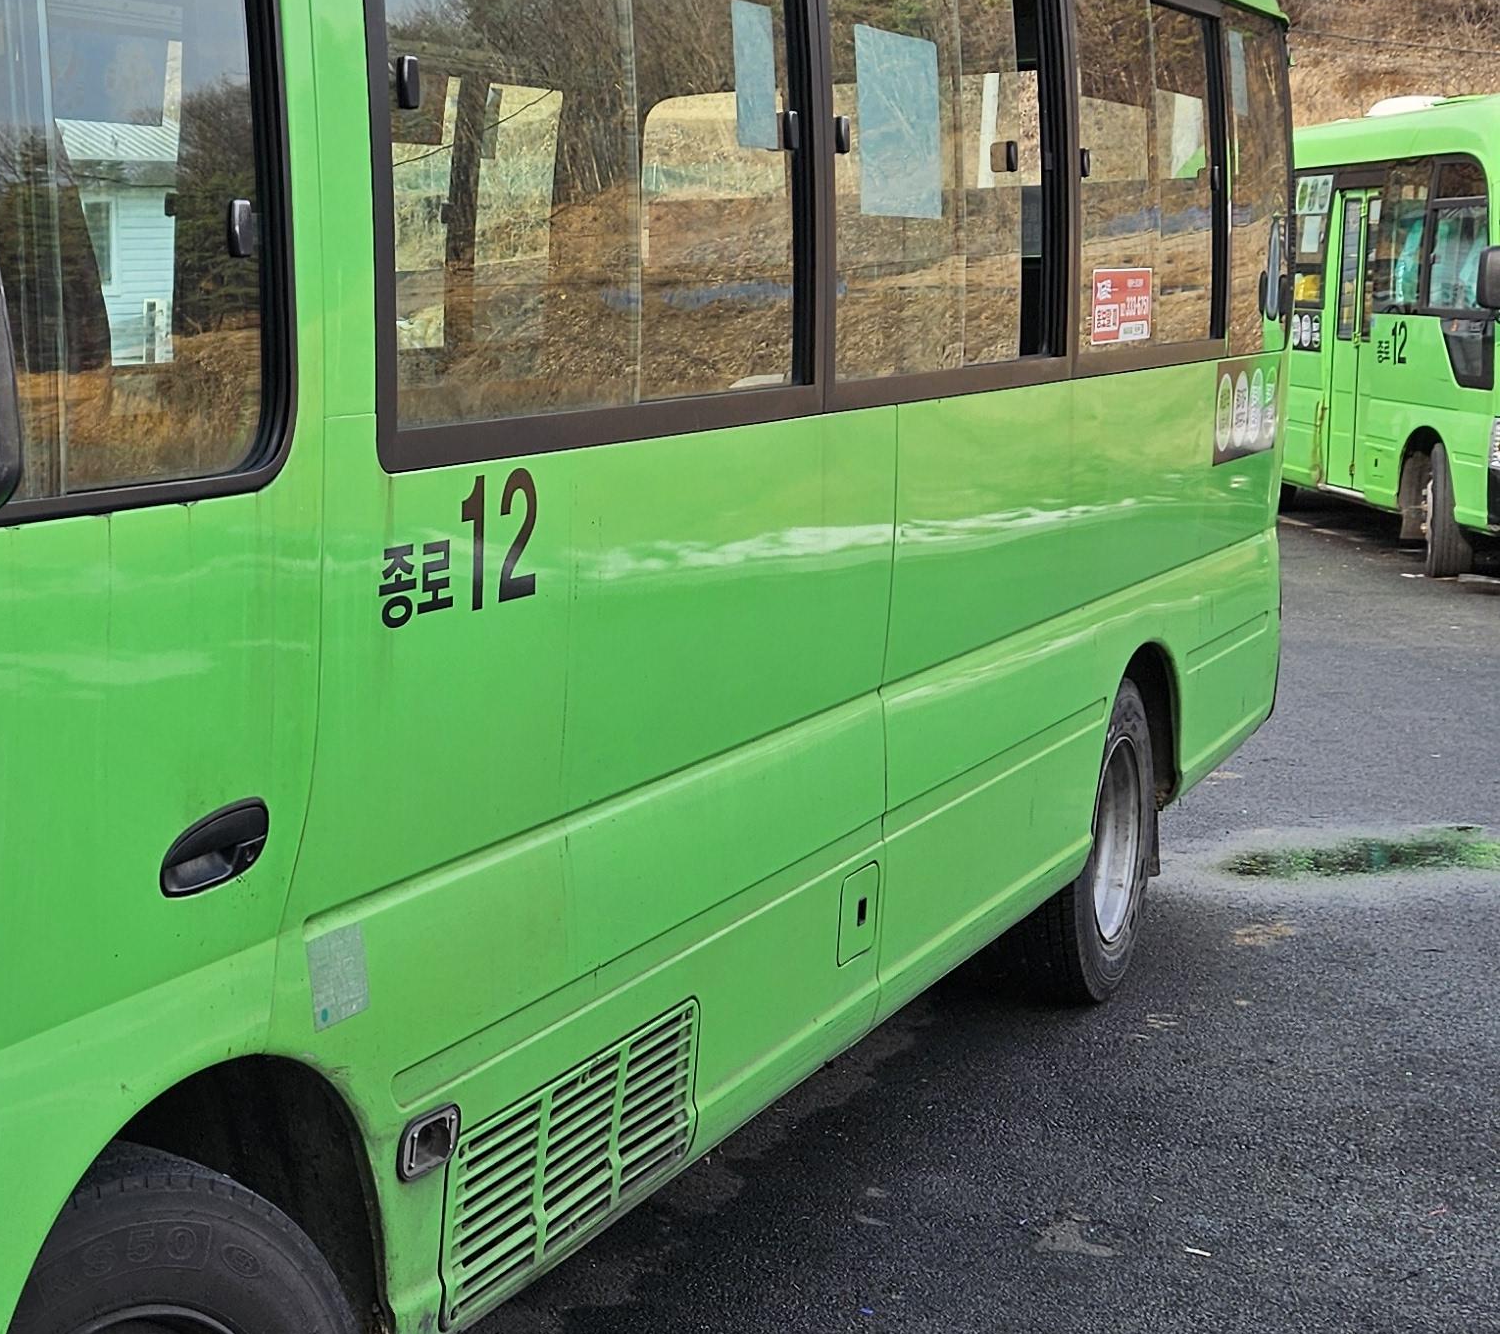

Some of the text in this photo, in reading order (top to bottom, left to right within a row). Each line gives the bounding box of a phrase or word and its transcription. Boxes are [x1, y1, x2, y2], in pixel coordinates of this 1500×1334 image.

[1391, 320, 1408, 365] 12
[378, 467, 538, 629] 종로 12
